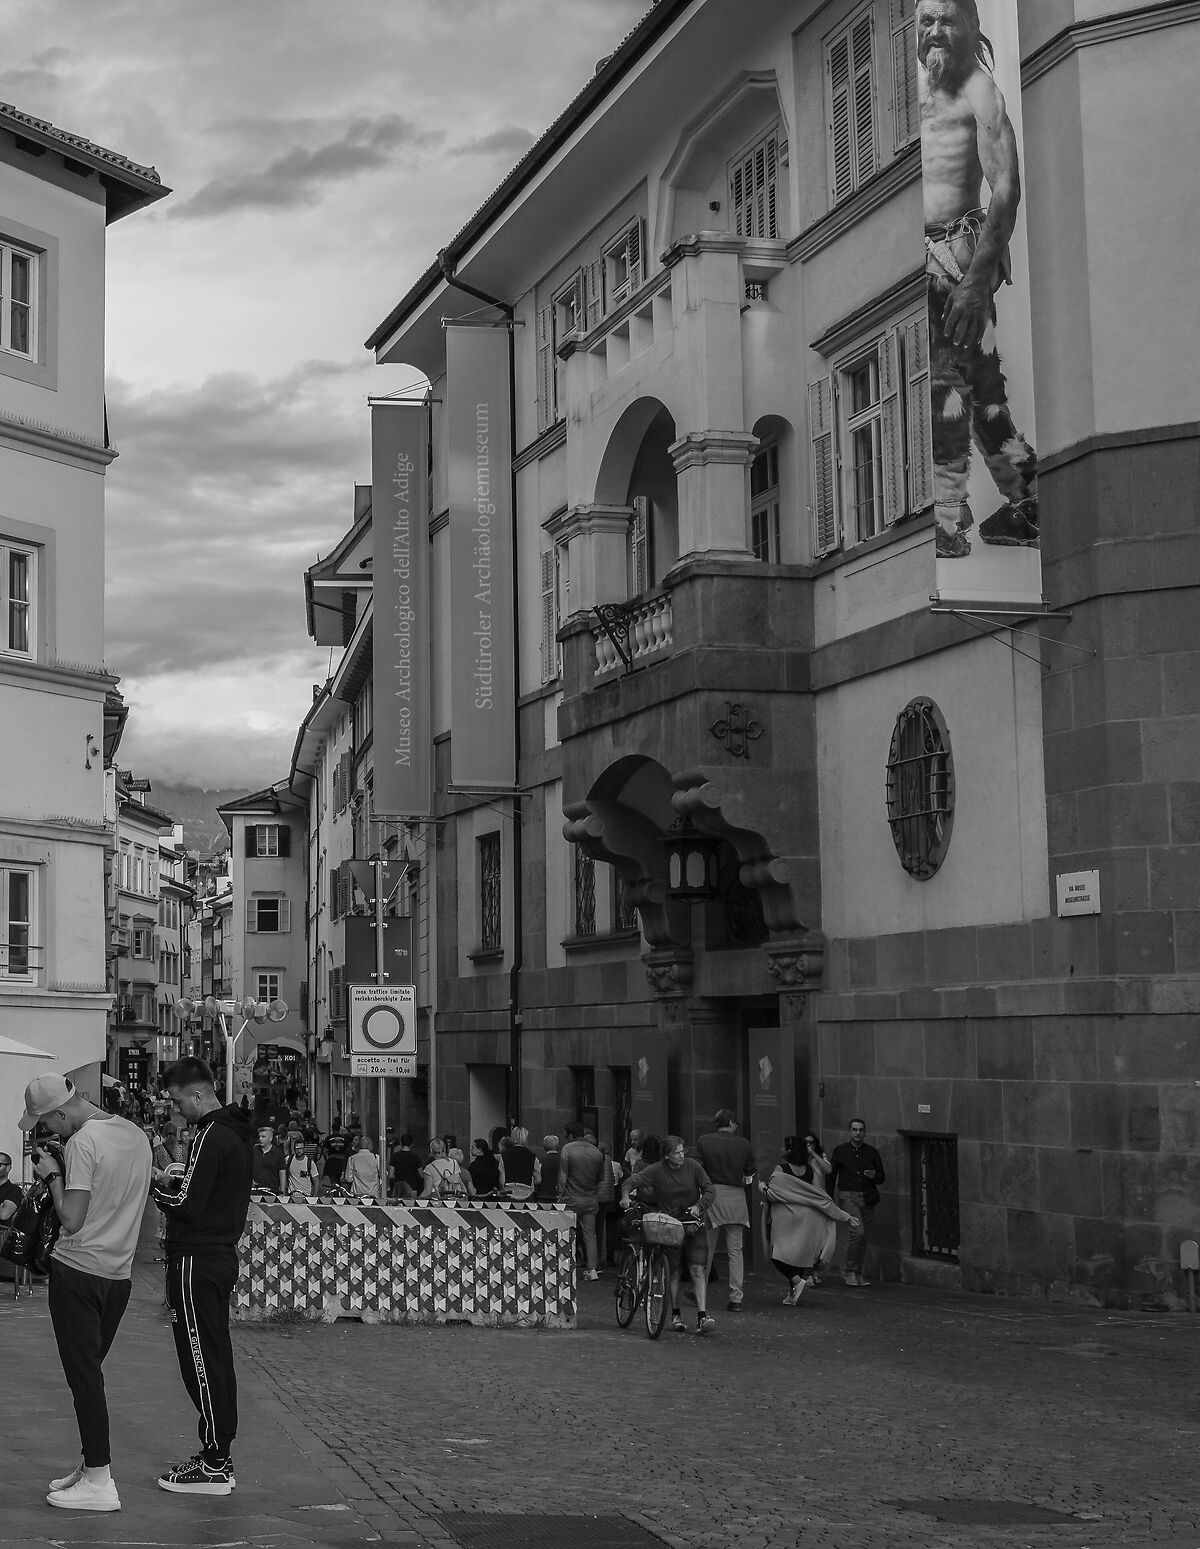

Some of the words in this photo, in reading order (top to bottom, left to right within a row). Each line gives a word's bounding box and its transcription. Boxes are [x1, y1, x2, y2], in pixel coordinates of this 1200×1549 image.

[393, 452, 414, 503] Adige
[472, 400, 496, 607] Archäologiemuseum
[394, 585, 415, 702] Archeologico
[474, 609, 493, 711] Südtiroler
[394, 707, 411, 766] Museo
[191, 1336, 205, 1378] GIVENCHY
